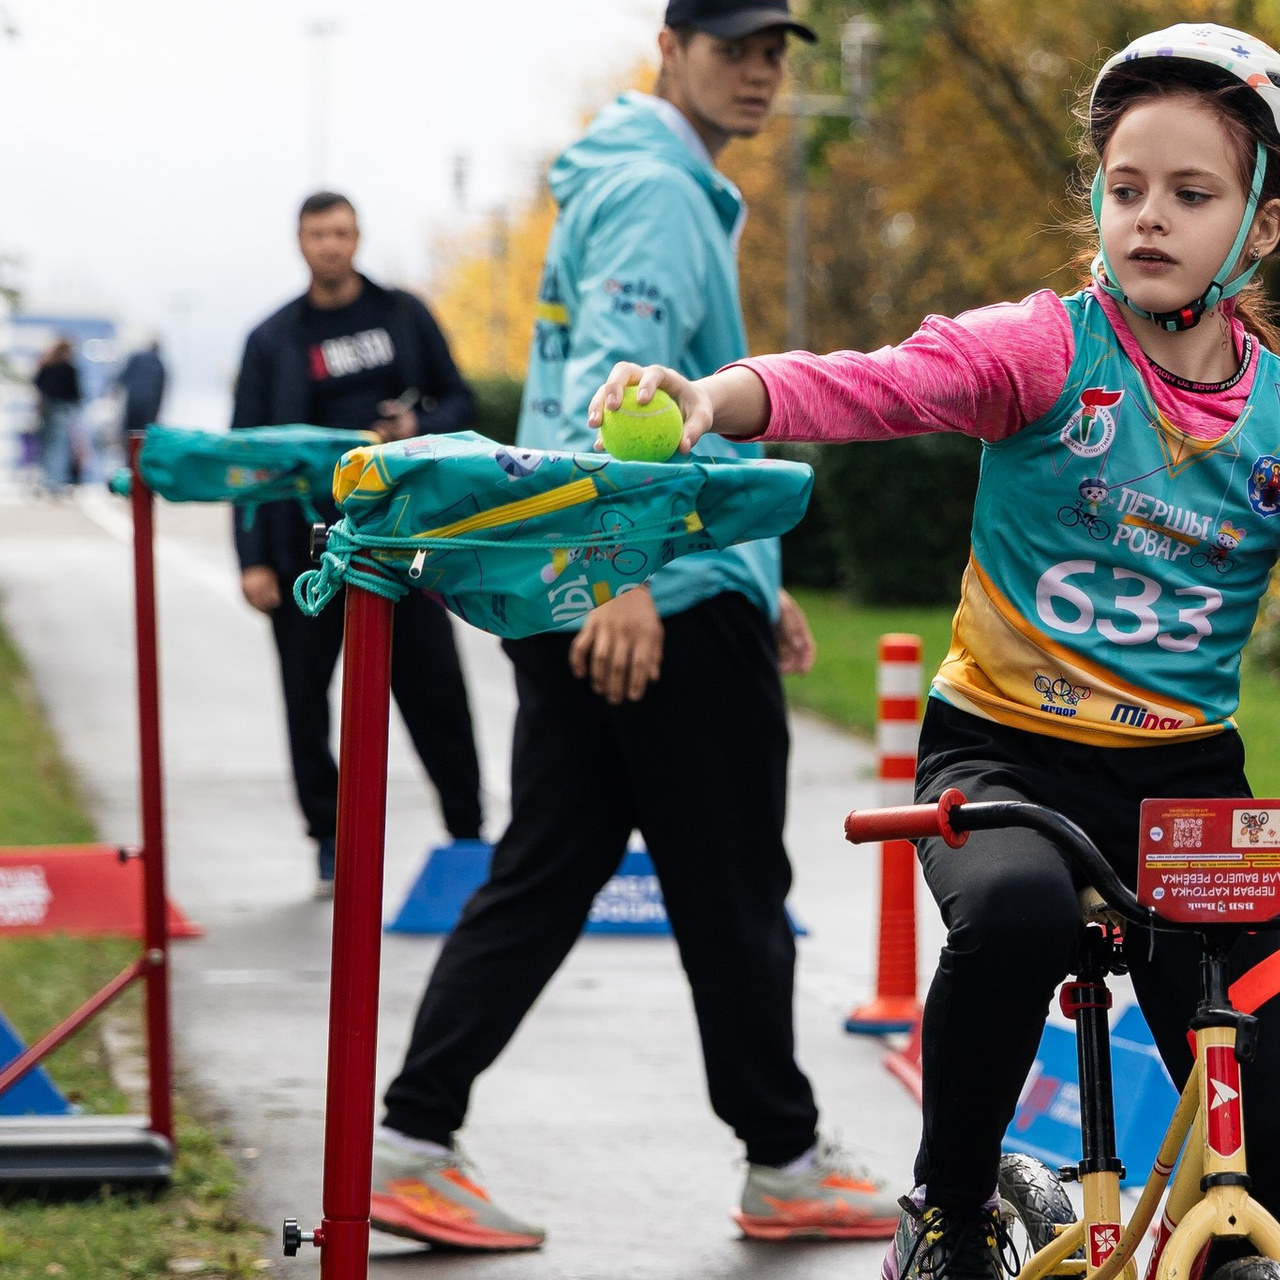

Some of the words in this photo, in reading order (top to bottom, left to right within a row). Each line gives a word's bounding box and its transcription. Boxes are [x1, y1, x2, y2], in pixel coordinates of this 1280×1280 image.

[1151, 363, 1176, 385] MOVE
[1177, 379, 1190, 389] TO
[1192, 383, 1219, 391] MADE
[1219, 373, 1241, 390] STYLE
[1116, 487, 1212, 541] ПЕРШЫ
[1112, 523, 1191, 562] РОВАР
[1036, 559, 1223, 653] 633
[1161, 873, 1211, 886] РЕБЁНКА
[1214, 873, 1259, 883] ВАШЕГО
[1171, 886, 1230, 897] КАРТОЧКА
[1233, 886, 1276, 896] ПЕРВАЯ
[1187, 901, 1216, 911] Bank
[1229, 902, 1254, 911] BSB
